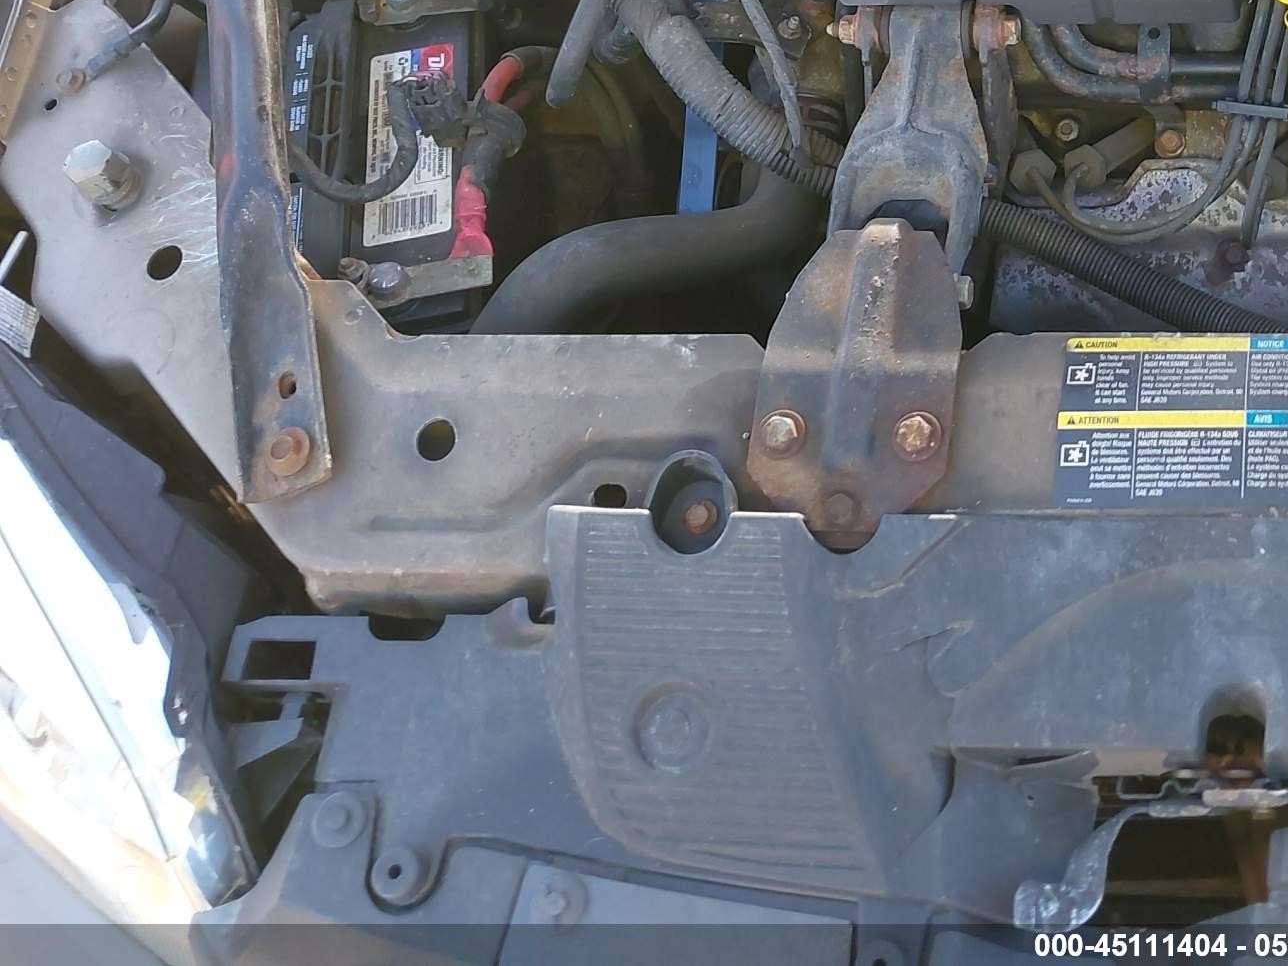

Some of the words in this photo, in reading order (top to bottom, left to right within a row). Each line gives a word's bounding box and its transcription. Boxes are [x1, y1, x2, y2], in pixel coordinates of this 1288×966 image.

[1086, 341, 1119, 349] CAUTION
[1257, 339, 1285, 349] NOTICE
[1078, 417, 1120, 425] ATTENTION
[1253, 414, 1273, 424] AVIS
